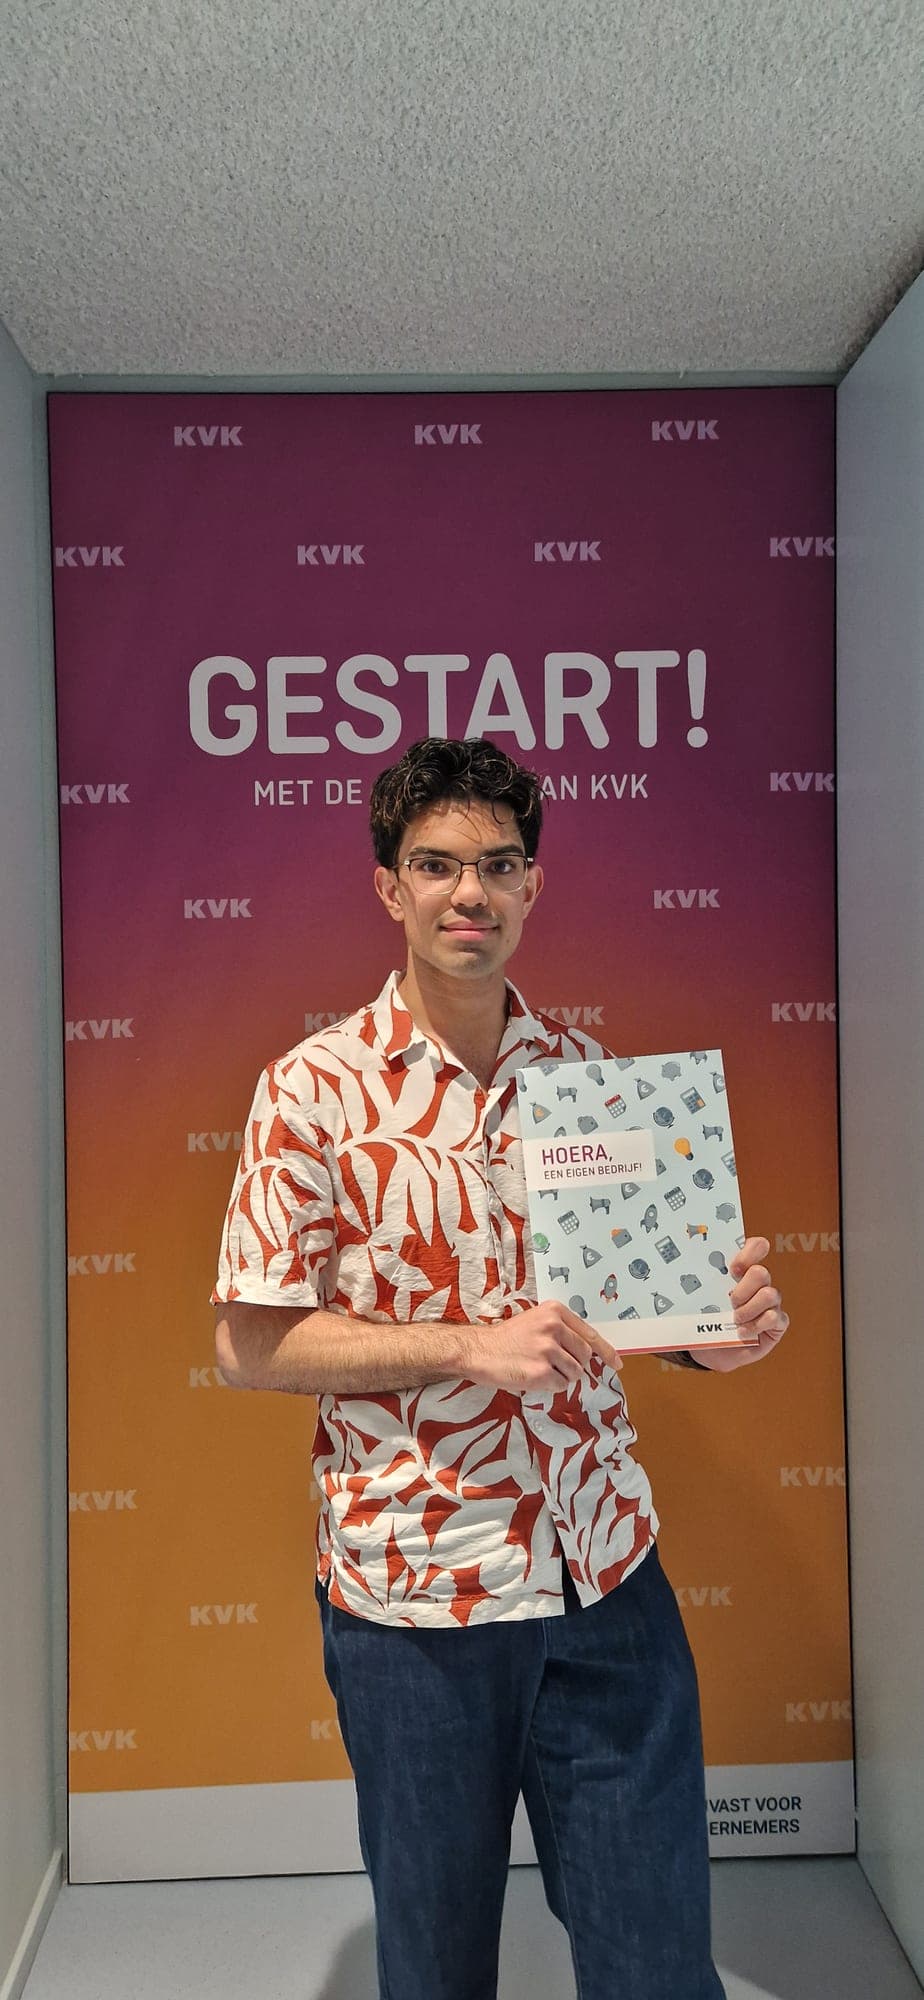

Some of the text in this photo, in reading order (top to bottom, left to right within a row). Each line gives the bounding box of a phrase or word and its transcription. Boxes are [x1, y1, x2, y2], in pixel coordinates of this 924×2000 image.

[173, 425, 243, 447] KVK
[414, 423, 482, 445] KVK
[651, 419, 719, 442] KVK
[55, 545, 125, 567] KVK
[297, 544, 365, 566] KVK
[534, 541, 600, 562] KVK
[769, 536, 835, 557] KVK
[188, 648, 709, 757] GESTART!
[254, 780, 314, 806] MET
[325, 779, 363, 805] DE
[591, 773, 649, 800] KVK
[769, 771, 835, 793] KVK
[60, 783, 130, 804] KVK
[183, 898, 252, 919] KVK
[653, 888, 720, 910] KVK
[304, 1012, 350, 1033] KV
[771, 1002, 836, 1022] KVK
[65, 1017, 135, 1042] KVK
[541, 1143, 614, 1166] HOERA,
[544, 1162, 643, 1180] EEN EIGEN BEDRIJF!
[775, 1231, 841, 1253] KVK
[67, 1253, 136, 1276] KVK
[696, 1323, 723, 1333] KVK
[780, 1466, 846, 1488] KVK
[69, 1488, 138, 1512] KVK
[189, 1603, 259, 1626] KVK
[786, 1700, 852, 1722] KVK
[69, 1729, 138, 1753] KVK
[706, 1796, 802, 1813] VAST VOOR
[709, 1818, 801, 1836] ERNEMERS
